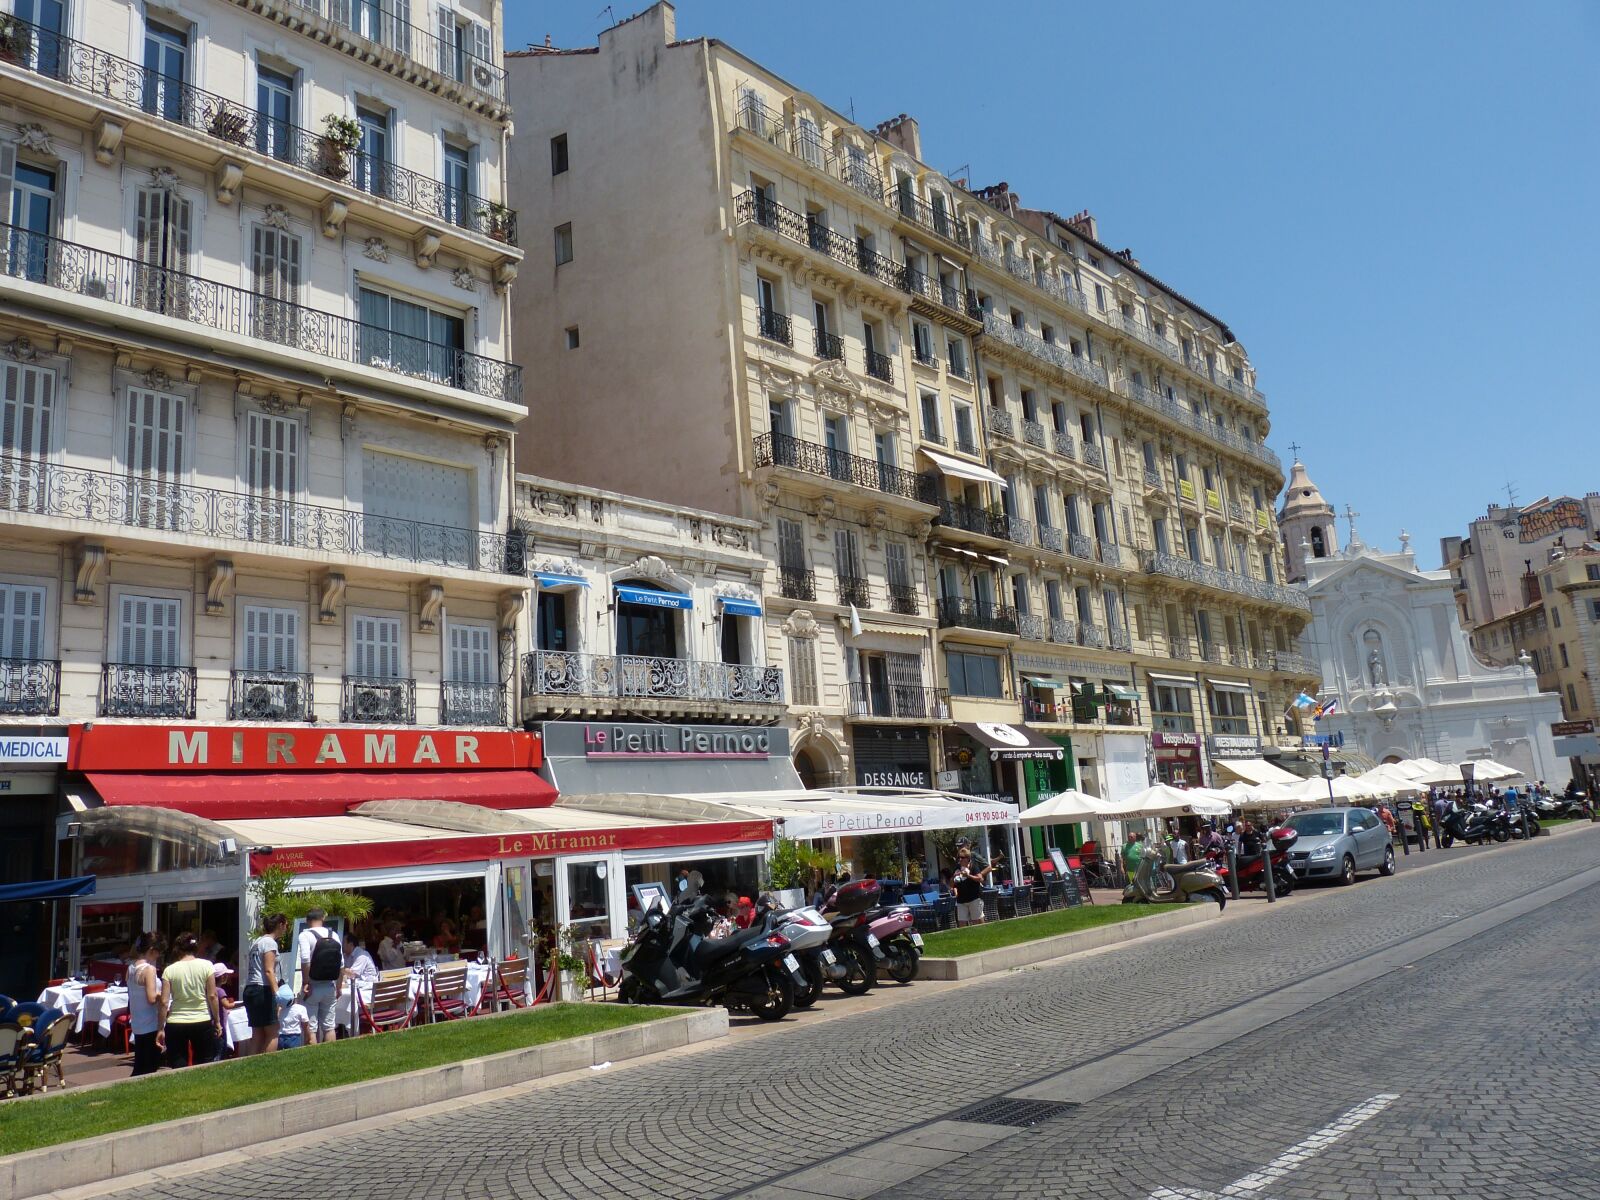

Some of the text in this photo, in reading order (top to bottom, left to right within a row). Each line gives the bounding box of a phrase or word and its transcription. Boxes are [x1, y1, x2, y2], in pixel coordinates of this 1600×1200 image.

[644, 595, 658, 604] Petit
[658, 597, 680, 607] Pernod
[585, 725, 770, 752] Le Petit Pernod
[1215, 737, 1259, 748] RESTAURANT
[168, 730, 480, 764] MIRAMAR
[864, 772, 924, 786] DESSANGE
[821, 811, 923, 830] Le Petit Pernod
[965, 812, 974, 822] 04
[975, 812, 982, 821] 91
[982, 811, 990, 821] 90
[991, 811, 999, 820] 50
[1000, 810, 1008, 819] 04
[1097, 811, 1142, 821] COLUMBUS
[498, 833, 616, 854] Le Miramar
[276, 852, 304, 861] LA VRAIE
